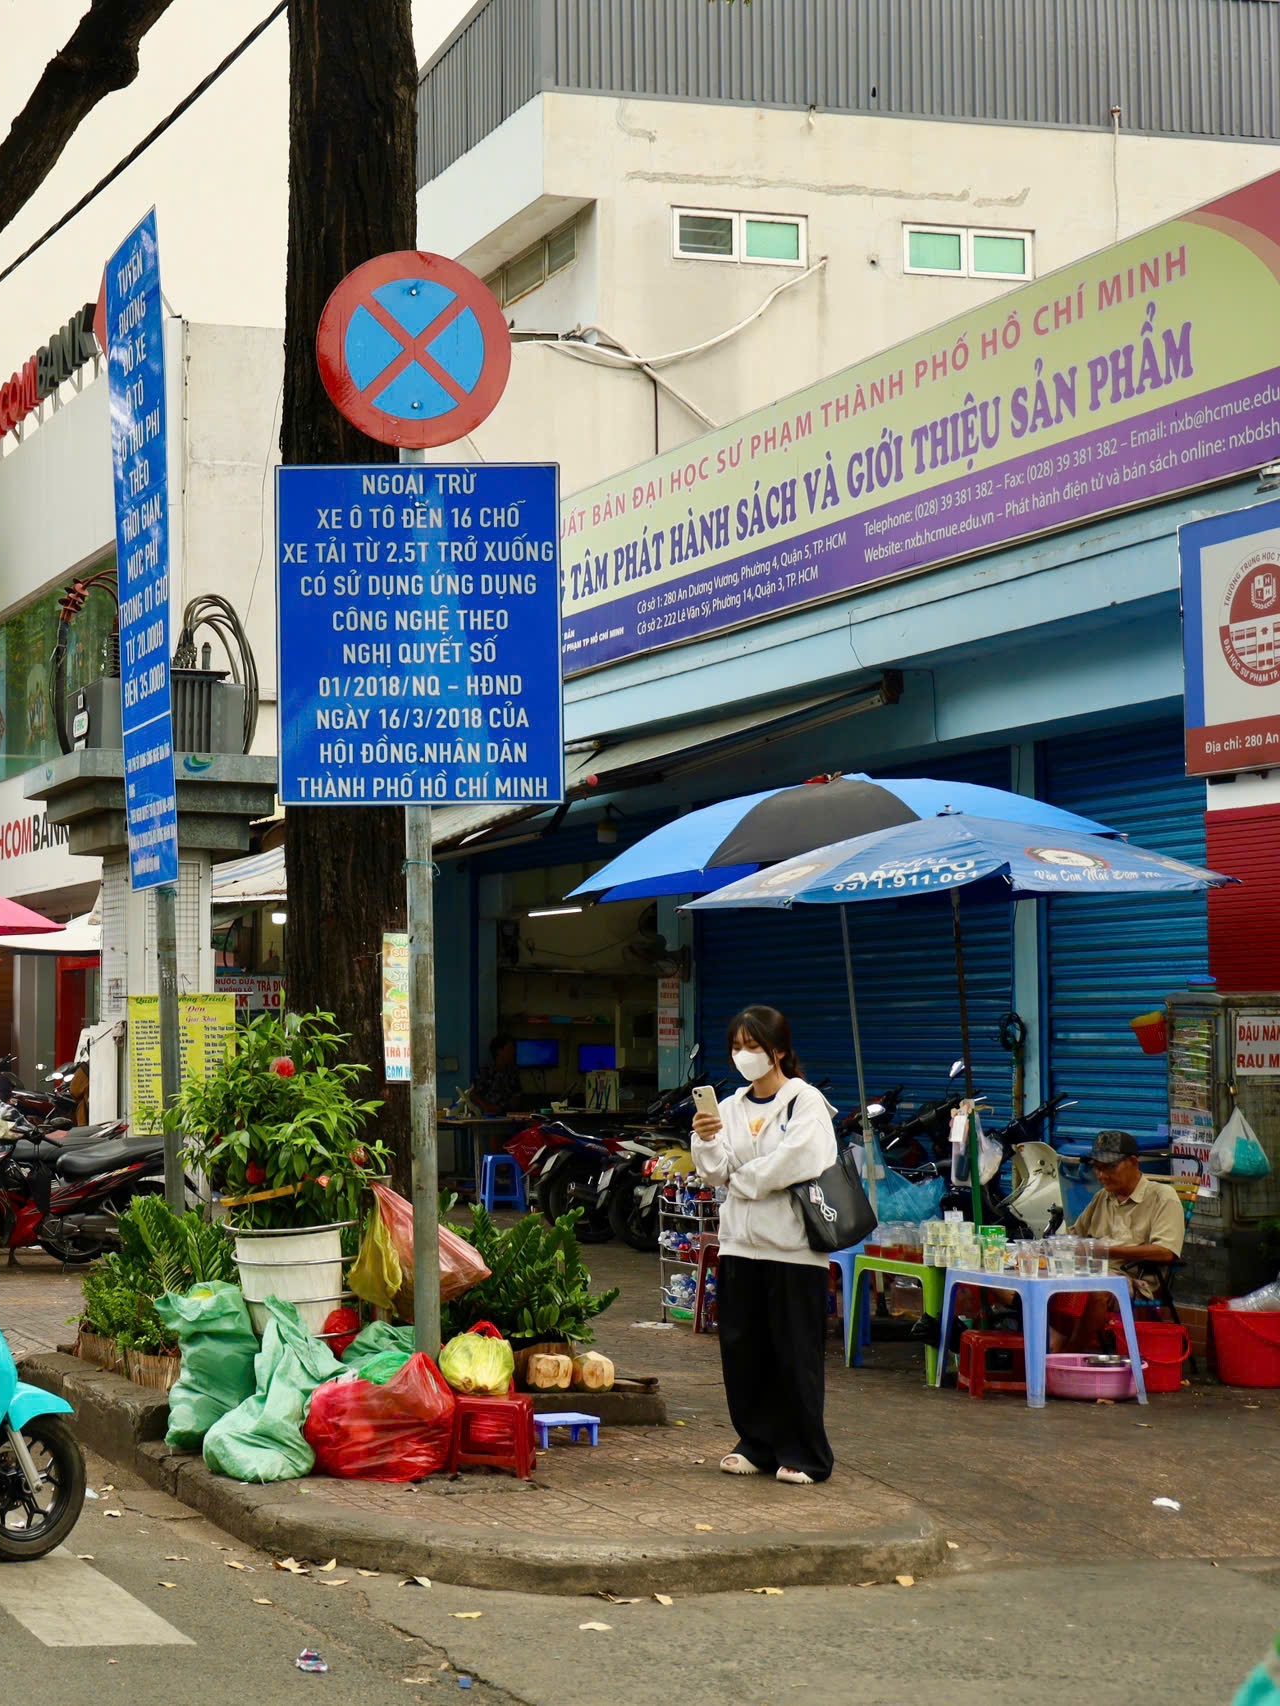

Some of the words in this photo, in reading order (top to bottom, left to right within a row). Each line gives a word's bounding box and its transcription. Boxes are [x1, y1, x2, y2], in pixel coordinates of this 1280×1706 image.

[136, 342, 147, 368] XE
[592, 493, 625, 526] BẢN
[633, 478, 663, 510] ĐẠI
[670, 457, 709, 493] HỌC
[717, 439, 743, 474] SƯ
[751, 410, 812, 459] PHẠM
[820, 370, 904, 427] THÀNH
[915, 331, 969, 388] PHỐ
[981, 309, 1021, 360] HỒ
[1033, 283, 1087, 336] CHÍ
[1098, 245, 1186, 311] MINH
[571, 548, 608, 600] TÂM
[614, 526, 664, 586] PHÁT
[670, 508, 730, 566] HÀNH
[736, 480, 797, 541] SÁCH
[803, 451, 840, 515] VÀ
[847, 427, 904, 499] GIỚI
[911, 392, 1001, 475] THIỆU
[1010, 357, 1077, 438] SẢN
[1087, 301, 1194, 411] PHẨM
[129, 459, 149, 497] THEO
[362, 474, 424, 498] NGOẠI
[436, 469, 477, 495] TRỪ
[864, 510, 913, 537] Telephone:
[915, 498, 938, 521] (028)
[941, 494, 953, 511] 39
[955, 488, 971, 507] 381
[975, 480, 993, 500] 382
[1005, 472, 1024, 489] Fax:
[1027, 459, 1054, 484] (028)
[1057, 454, 1070, 472] 39
[1073, 447, 1091, 467] 381
[1096, 438, 1117, 460] 382
[1130, 421, 1167, 448] Email:
[317, 509, 342, 529] XE
[350, 504, 362, 529] Ô
[370, 505, 395, 529] TÔ
[402, 500, 443, 529] ĐẾN
[451, 509, 472, 527] 16
[479, 500, 526, 528] CHỖ
[864, 542, 904, 563] Website:
[905, 512, 994, 551] nxb.hcmue.edu.vn
[1006, 497, 1029, 518] Phát
[1032, 488, 1060, 510] hành
[1063, 481, 1088, 500] điện
[1091, 472, 1104, 491] tử
[1106, 468, 1120, 487] và
[1123, 461, 1146, 482] bán
[1150, 448, 1177, 474] sách
[1181, 439, 1226, 464] online:
[283, 543, 307, 563] XE
[315, 537, 346, 563] TẢI
[353, 537, 380, 563] TỪ
[387, 542, 429, 565] 2,5T
[438, 536, 478, 562] TRỞ
[484, 533, 554, 562] XUỐNG
[1240, 554, 1260, 573] TRUNG
[301, 570, 326, 596] CÓ
[333, 569, 361, 596] SỬ
[369, 576, 424, 600] DỤNG
[430, 569, 474, 595] ỨNG
[481, 574, 537, 599] DỤNG
[657, 596, 663, 608] 1:
[664, 591, 676, 606] 280
[678, 588, 687, 602] An
[689, 581, 713, 598] Dương
[741, 561, 770, 580] Phường
[781, 549, 802, 567] Quận
[813, 540, 824, 555] TP.
[826, 531, 847, 551] HCM
[120, 593, 143, 630] TRONG
[145, 591, 153, 612] 01
[656, 618, 663, 630] 2:
[664, 612, 676, 627] 222
[678, 609, 686, 623] Lê
[713, 594, 741, 612] Phường
[755, 581, 776, 598] Quận
[786, 573, 797, 588] TP.
[799, 565, 818, 584] HCM
[333, 607, 387, 632] CÔNG
[395, 605, 450, 634] NGHỆ
[457, 610, 509, 630] THEO
[343, 644, 391, 668] NGHỊ
[399, 636, 463, 664] QUYẾT
[470, 635, 500, 663] SỐ
[319, 677, 440, 697] 01/2018/NQ
[467, 675, 522, 695] HĐND
[1249, 671, 1268, 684] PHẠM
[316, 706, 370, 729] NGÀY
[379, 708, 482, 729] 16/3/2018
[489, 701, 529, 728] CỦA
[320, 740, 354, 768] HỘI
[361, 734, 418, 763] ĐỒNG
[424, 740, 481, 763] NHÂN
[487, 740, 528, 763] DÂN
[1205, 740, 1221, 754] Địa
[1245, 733, 1263, 748] 280
[1265, 730, 1279, 745] An
[298, 772, 365, 798] THÀNH
[373, 770, 416, 797] PHỐ
[420, 770, 447, 797] HỒ
[455, 770, 489, 797] CHÍ
[496, 777, 548, 797] MINH
[1237, 1054, 1264, 1068] RAU
